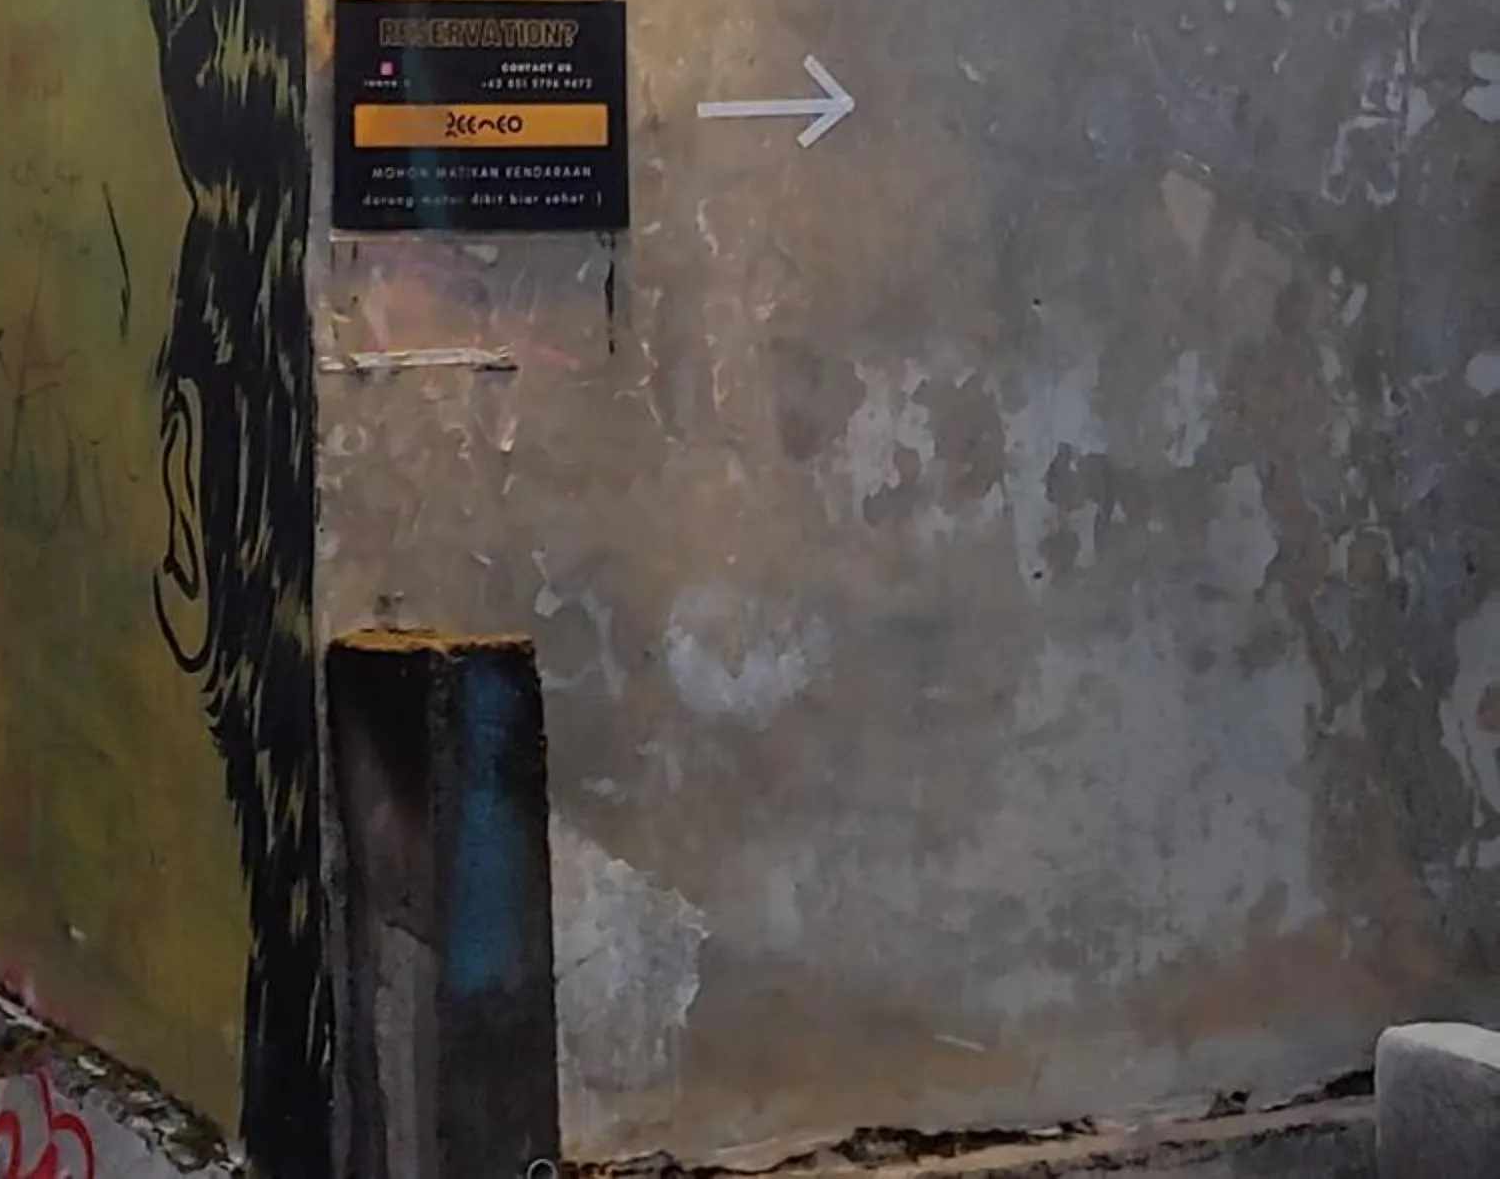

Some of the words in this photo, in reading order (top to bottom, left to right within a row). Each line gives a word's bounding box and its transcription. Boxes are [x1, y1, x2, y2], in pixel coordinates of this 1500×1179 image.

[501, 62, 553, 73] CONTACT
[372, 166, 429, 179] MOHON
[505, 166, 591, 179] KENDARAAN
